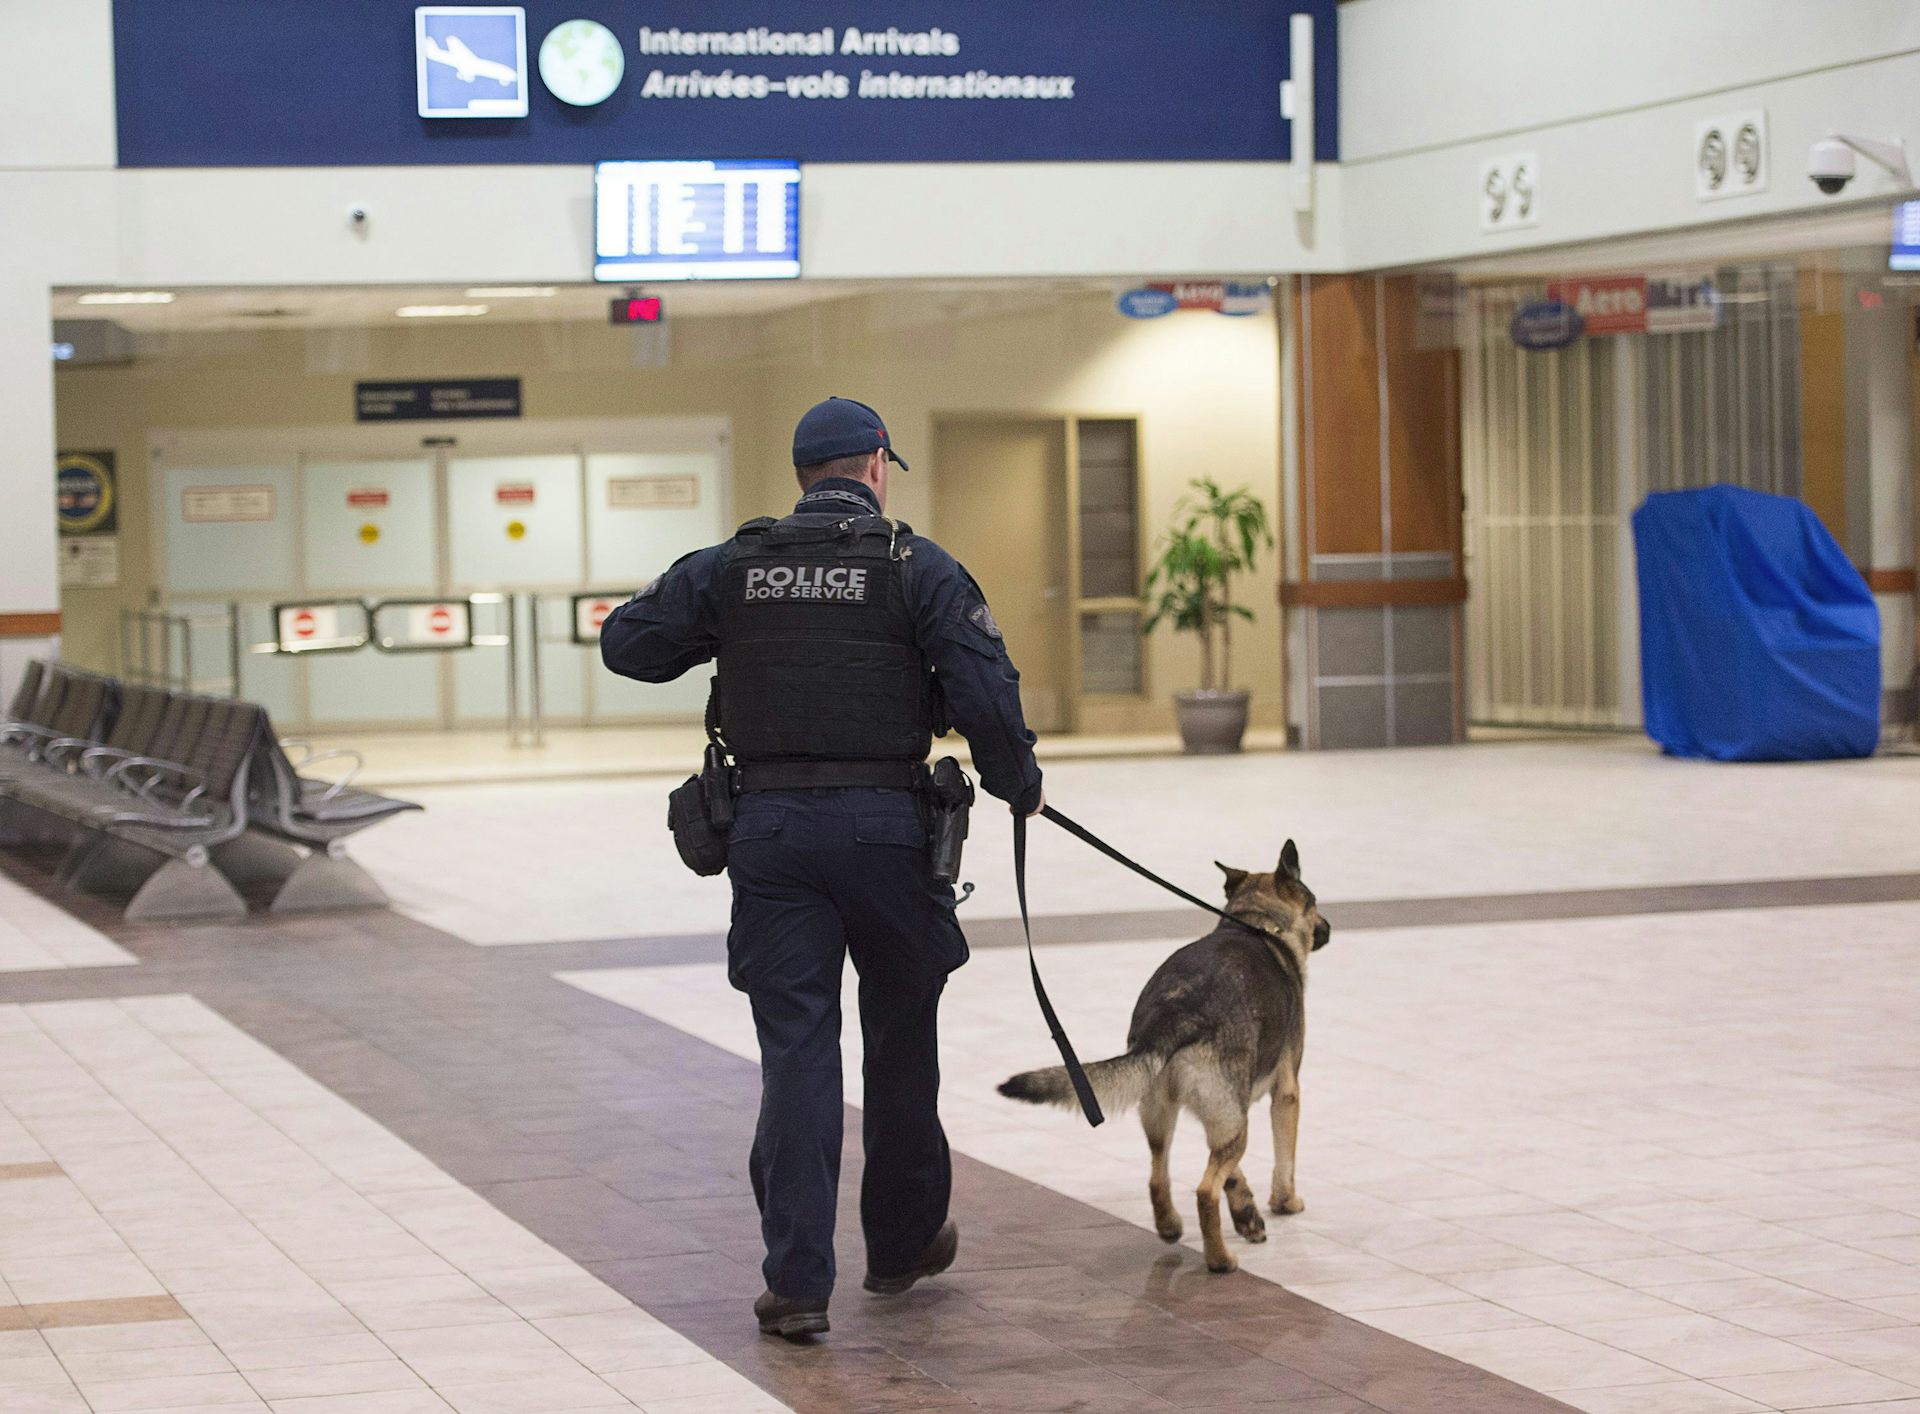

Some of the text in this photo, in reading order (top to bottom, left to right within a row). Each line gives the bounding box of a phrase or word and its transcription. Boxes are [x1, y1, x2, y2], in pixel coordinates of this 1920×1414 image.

[639, 26, 960, 56] International Arrivals
[857, 69, 1076, 99] internationaux
[746, 566, 868, 589] POLICE
[745, 586, 865, 600] DOG SERVICE
